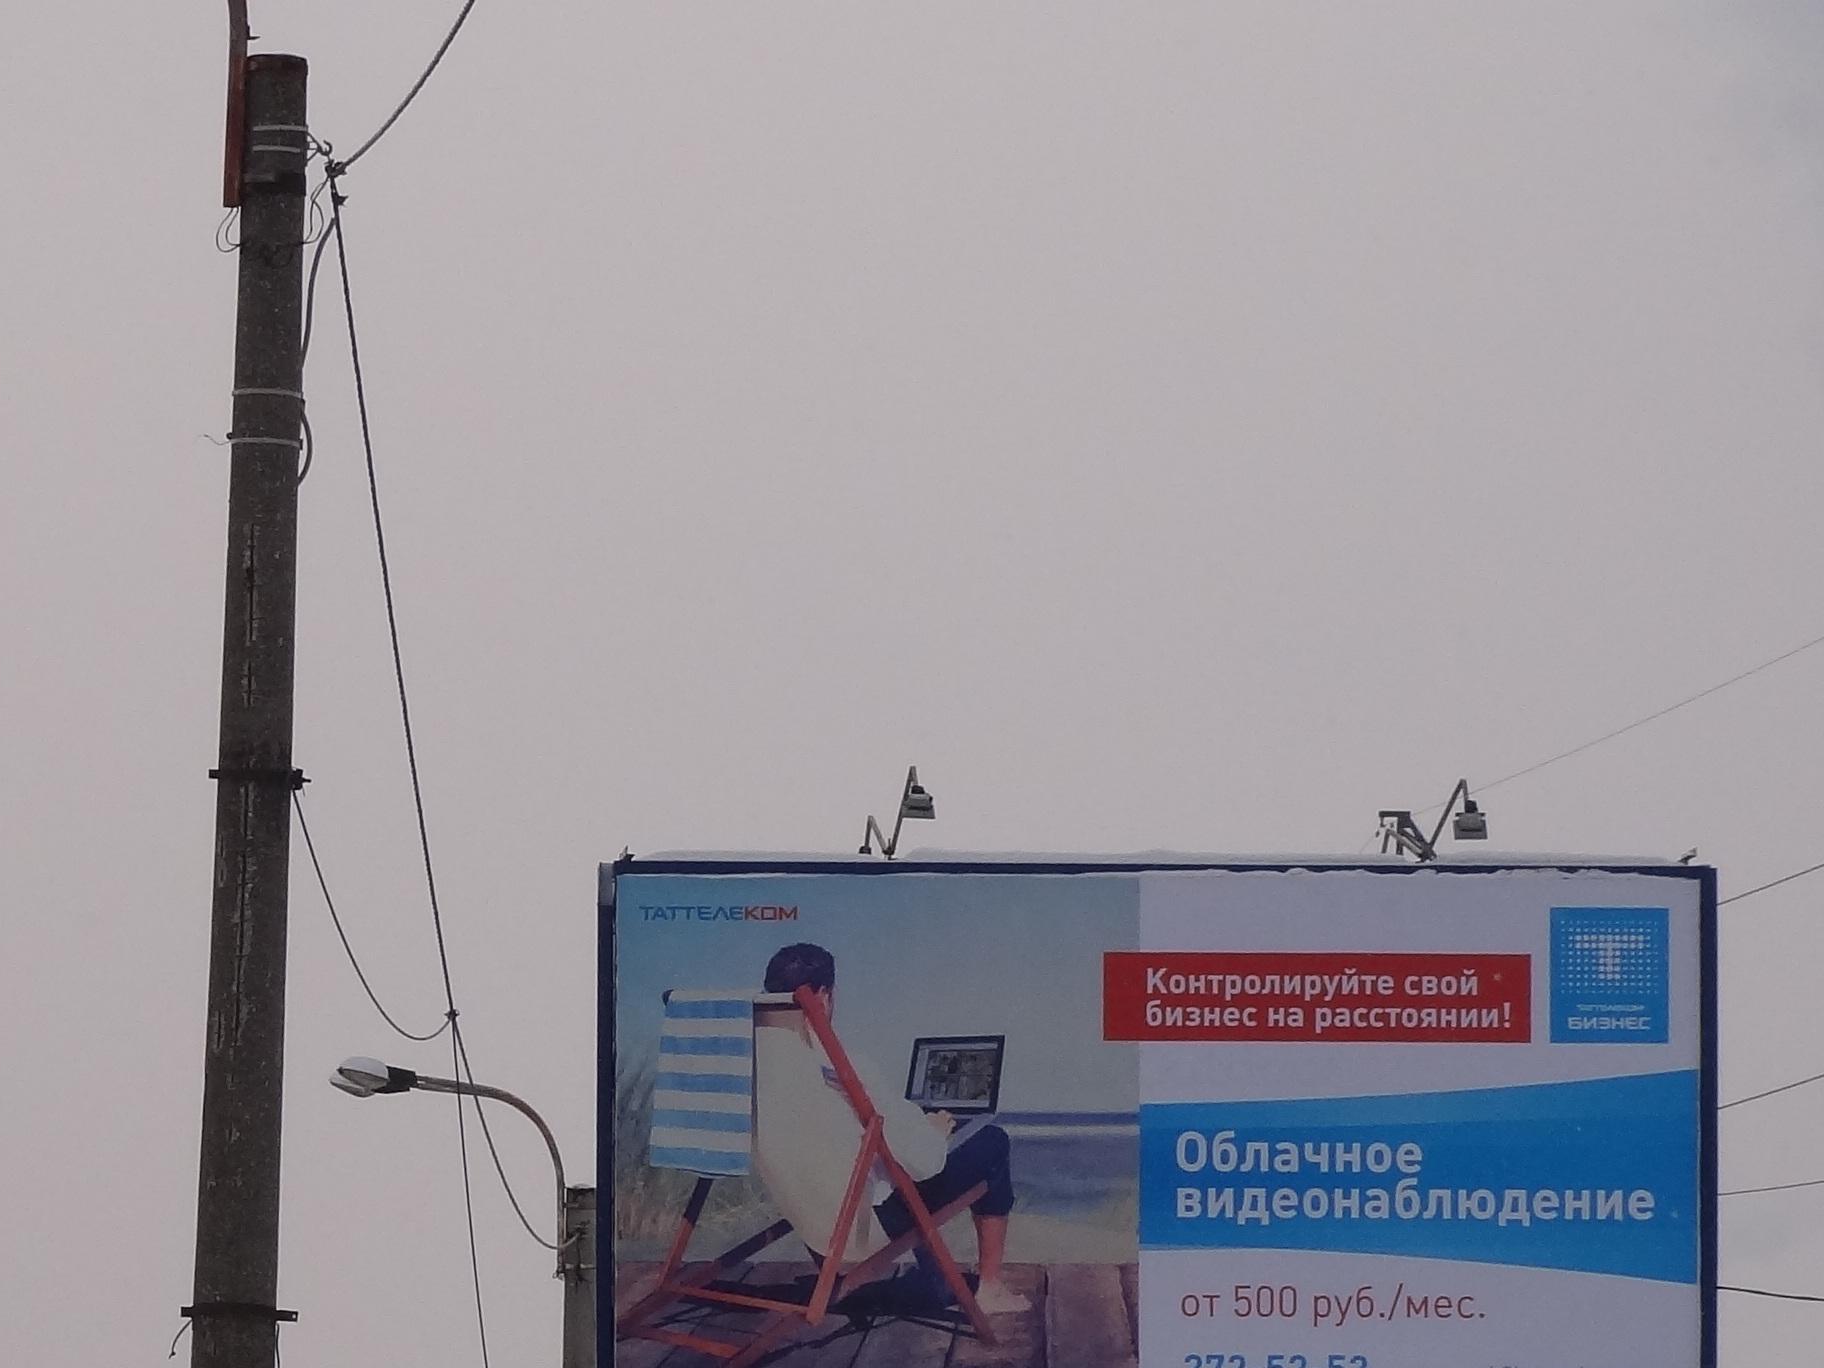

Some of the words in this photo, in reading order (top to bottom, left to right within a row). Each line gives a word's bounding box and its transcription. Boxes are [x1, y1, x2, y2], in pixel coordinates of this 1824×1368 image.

[638, 905, 799, 922] ТАТТЕЛЕКОМ
[1146, 967, 1395, 1001] Контролируйте
[1404, 969, 1479, 997] свой
[1145, 1000, 1258, 1028] бизнес
[1267, 1007, 1305, 1028] на
[1314, 1002, 1512, 1034] расстоянии!
[1567, 1016, 1651, 1031] БИЗНЕС
[1175, 1130, 1424, 1174] Облачное
[1175, 1177, 1656, 1227] видеонаблюдение
[1180, 1293, 1222, 1318] от
[1233, 1284, 1298, 1319] 500
[1312, 1282, 1486, 1328] руб./мес.
